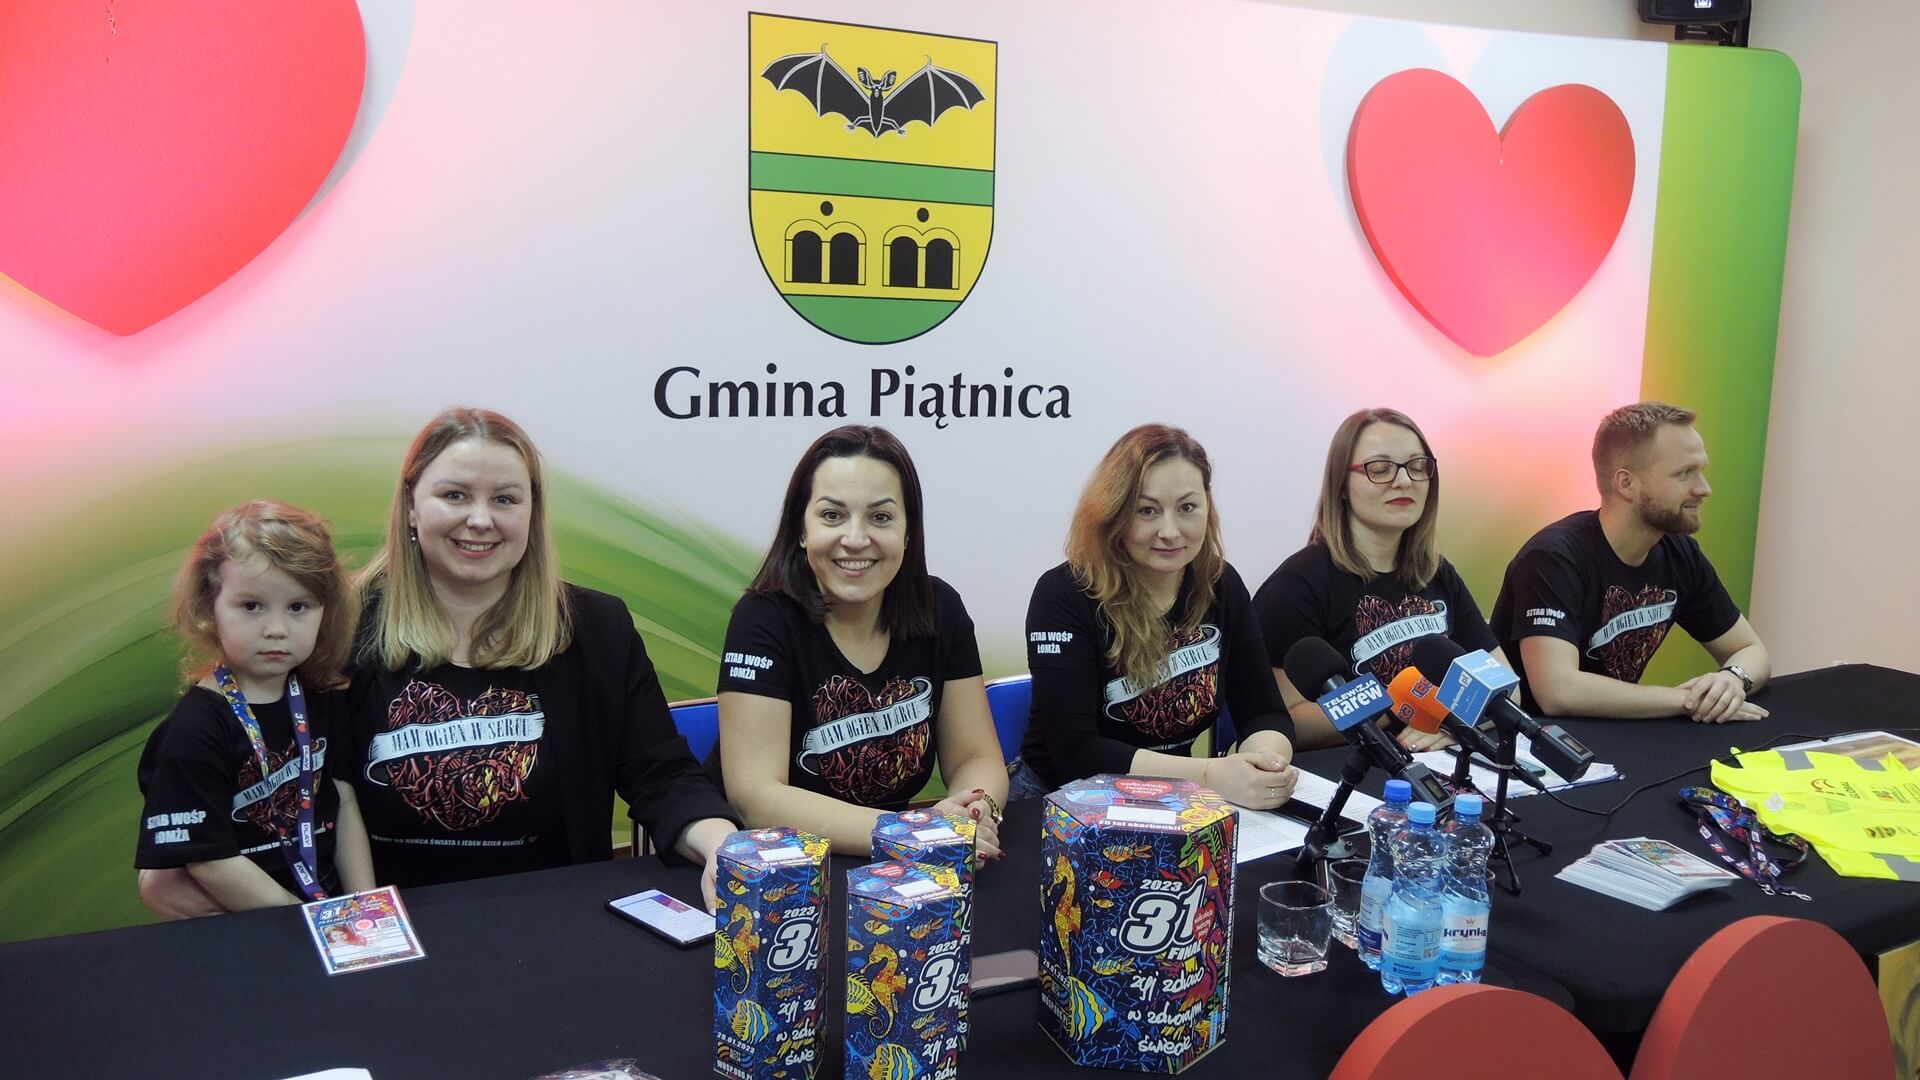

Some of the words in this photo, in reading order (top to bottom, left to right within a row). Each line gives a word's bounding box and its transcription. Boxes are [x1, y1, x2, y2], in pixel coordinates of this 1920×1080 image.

[653, 363, 848, 420] Gmina
[869, 365, 1072, 430] Piątnica
[1047, 631, 1073, 642] WOŚP
[744, 655, 774, 670] WOŚP
[730, 666, 756, 680] ŁOMŻA
[1323, 679, 1377, 709] TELEWIZJA
[1328, 684, 1383, 721] narew
[392, 728, 422, 752] MAM
[470, 722, 482, 740] W
[488, 717, 530, 738] SERCU
[170, 809, 207, 826] WOŚP
[303, 824, 311, 847] PLAY
[429, 838, 456, 846] ŚWIATA
[482, 839, 501, 847] DZIEŃ
[1139, 879, 1183, 893] 2023
[783, 906, 816, 919] 2023
[1119, 876, 1208, 954] 31
[927, 940, 958, 956] 2023
[1128, 1009, 1142, 1021] w
